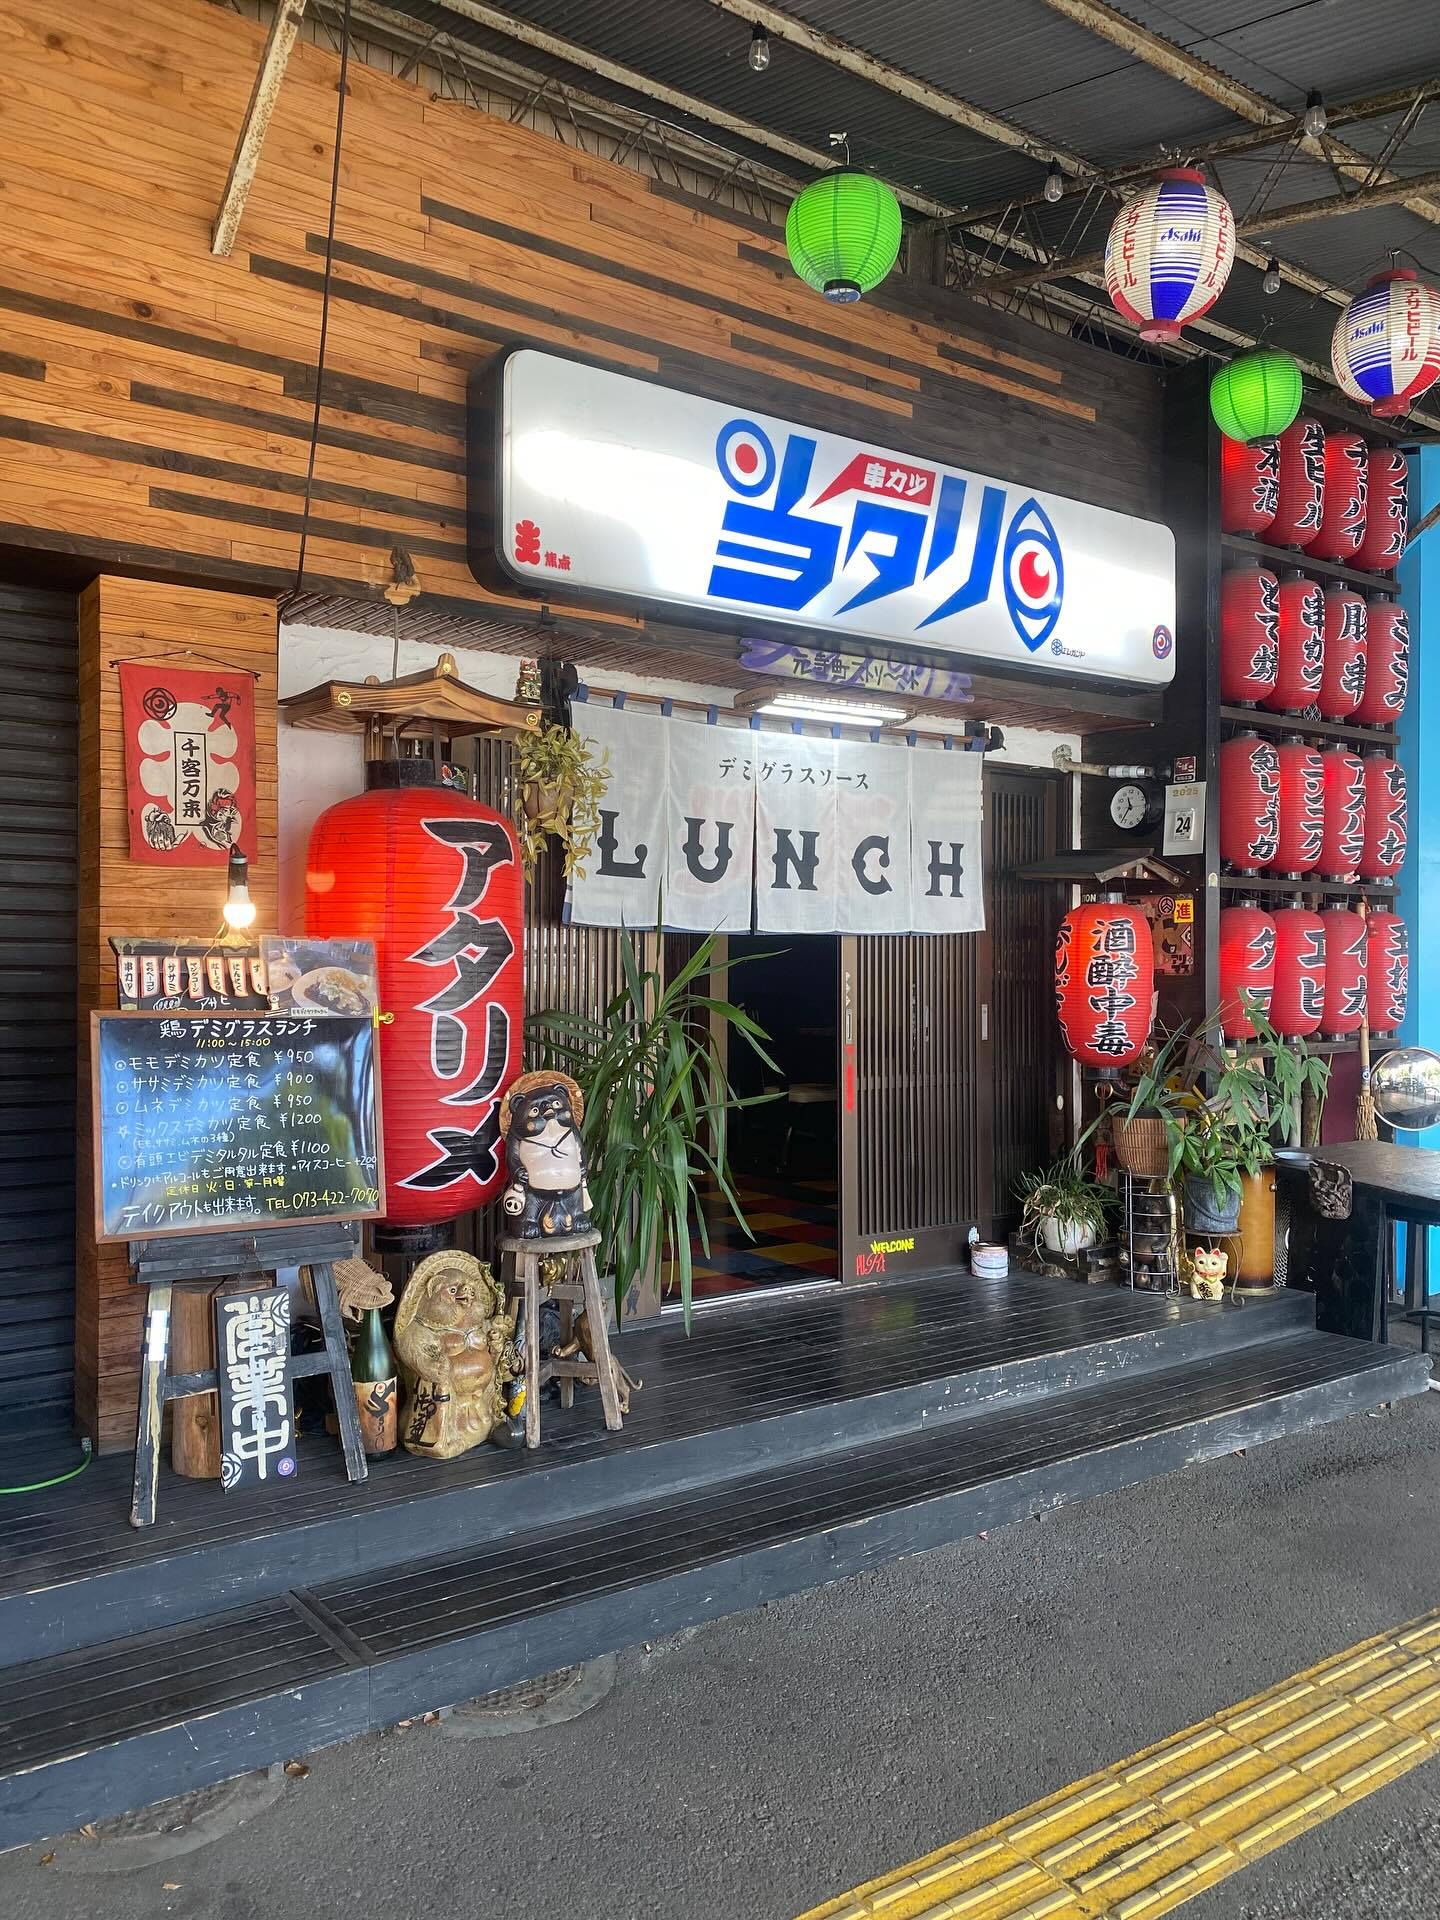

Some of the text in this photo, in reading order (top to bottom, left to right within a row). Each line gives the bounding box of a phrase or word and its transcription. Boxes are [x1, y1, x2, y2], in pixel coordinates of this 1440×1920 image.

[1122, 199, 1146, 288] アサヒビール
[1160, 228, 1202, 243] Asahi
[1202, 199, 1229, 288] アサヒビール
[1350, 319, 1385, 342] Asahi
[1400, 287, 1422, 362] アサヒビール
[863, 462, 928, 497] 串カツ
[1294, 423, 1325, 530] 生ビール
[181, 737, 202, 819] 千客万来
[718, 757, 870, 791] デミグラスソース
[1172, 787, 1200, 797] 2025
[1175, 816, 1191, 834] 24
[596, 809, 965, 898] LUNCH
[1177, 902, 1191, 920] 進
[167, 963, 177, 992] ササミ
[232, 962, 242, 992] にんにく
[1086, 917, 1139, 1057] 酒酔中毒
[1297, 928, 1326, 1019] エビ
[395, 818, 515, 1190] アタリメ
[128, 1051, 261, 1070] モモデミカツ定食
[131, 1074, 262, 1093] ササミデミカツ定食
[134, 1095, 262, 1114] ムネデミカツ定食
[134, 1114, 271, 1137] ミックスデミカツ定食
[134, 1141, 287, 1168] 有頭エビデミタルタル定食
[297, 1157, 352, 1172] アイスコーヒー
[165, 1184, 199, 1197] 定休日
[265, 1188, 379, 1212] TEL 073-422-7070
[870, 1238, 915, 1255] WELCOME
